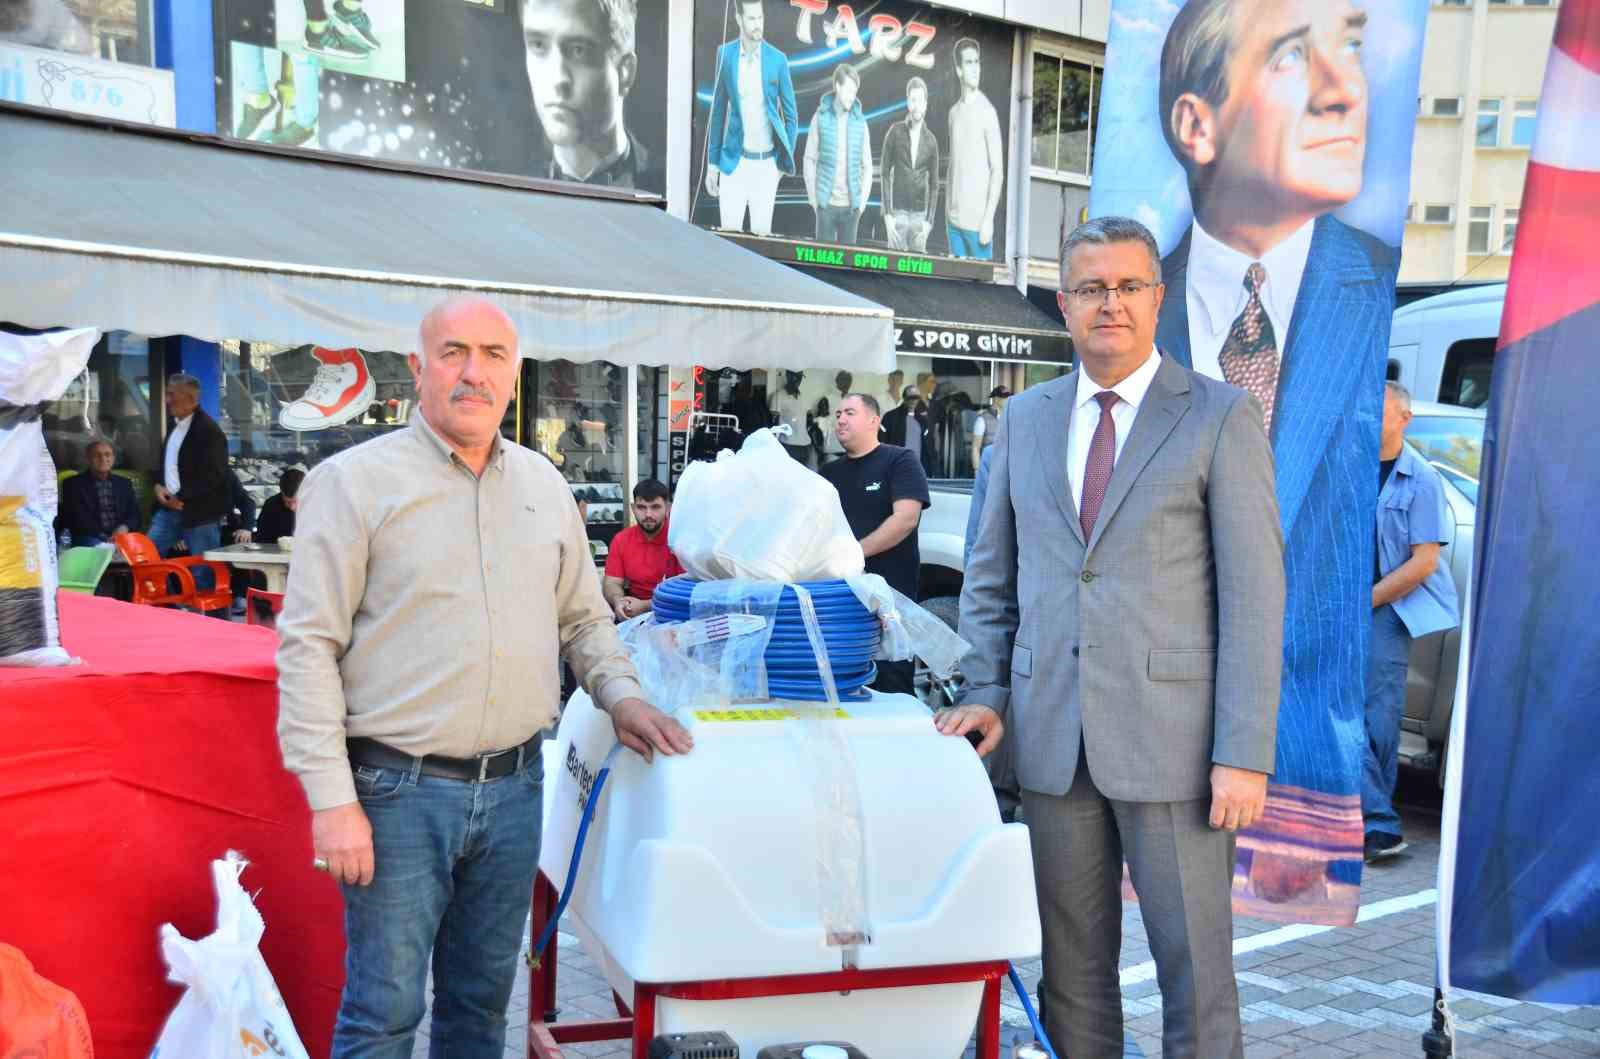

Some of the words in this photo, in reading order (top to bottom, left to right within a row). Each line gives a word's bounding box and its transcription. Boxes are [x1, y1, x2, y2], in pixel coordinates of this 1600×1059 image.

[790, 0, 936, 70] TARZ
[795, 246, 844, 266] YILMAZ
[853, 252, 889, 270] SPOR
[913, 330, 970, 351] SPOR
[977, 333, 1032, 355] GİYİM
